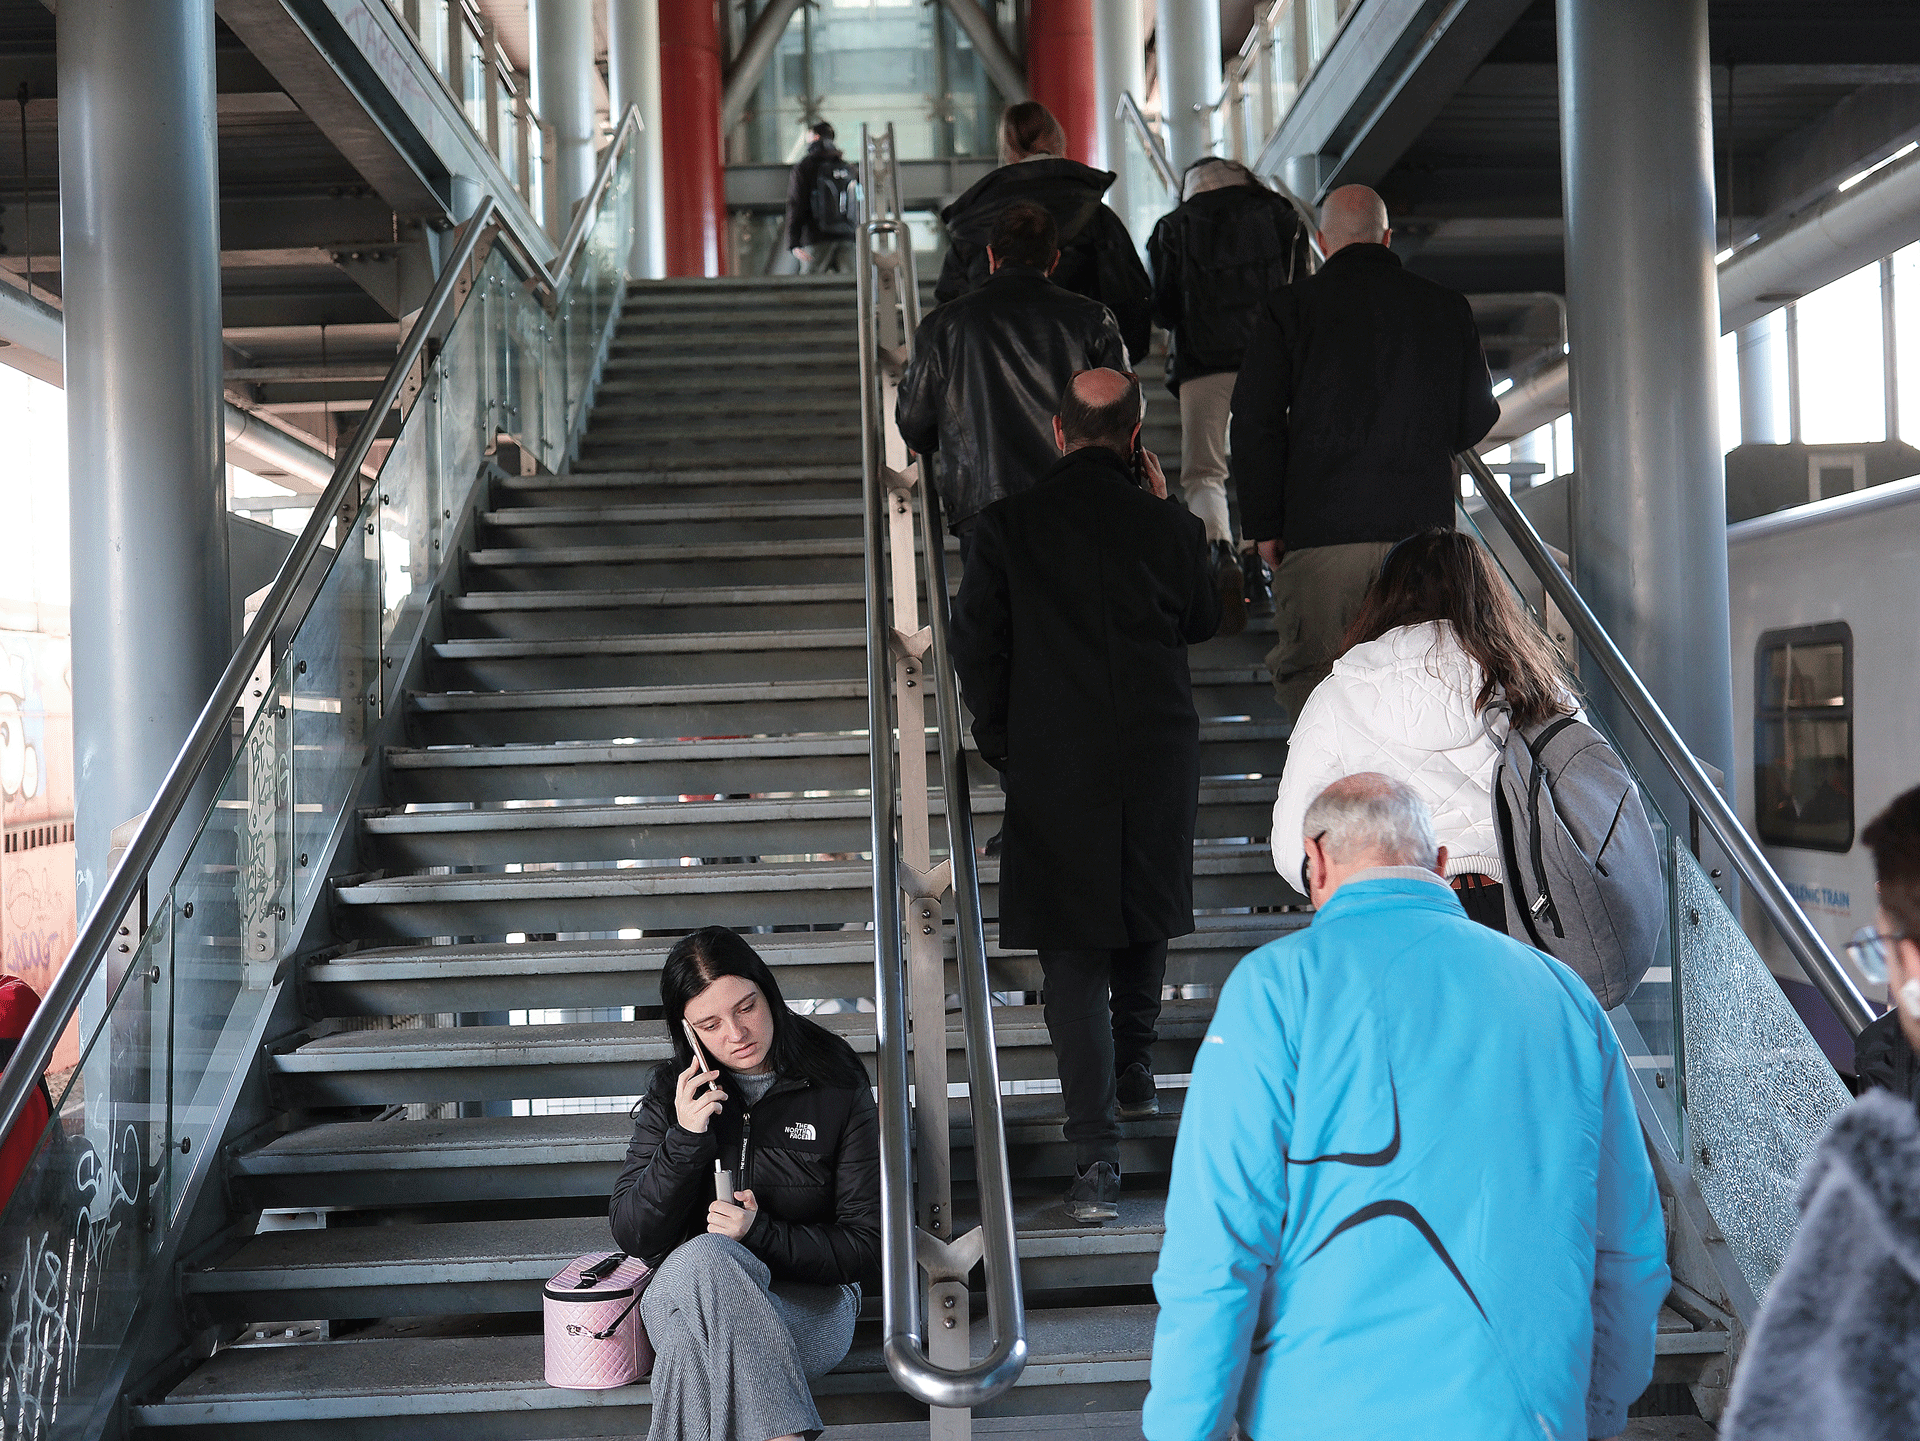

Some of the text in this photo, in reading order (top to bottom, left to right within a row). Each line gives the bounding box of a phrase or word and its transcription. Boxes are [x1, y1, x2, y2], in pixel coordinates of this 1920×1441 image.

[1821, 887, 1850, 908] TRAIN
[784, 1126, 807, 1134] NORTH
[789, 1132, 808, 1140] FACE
